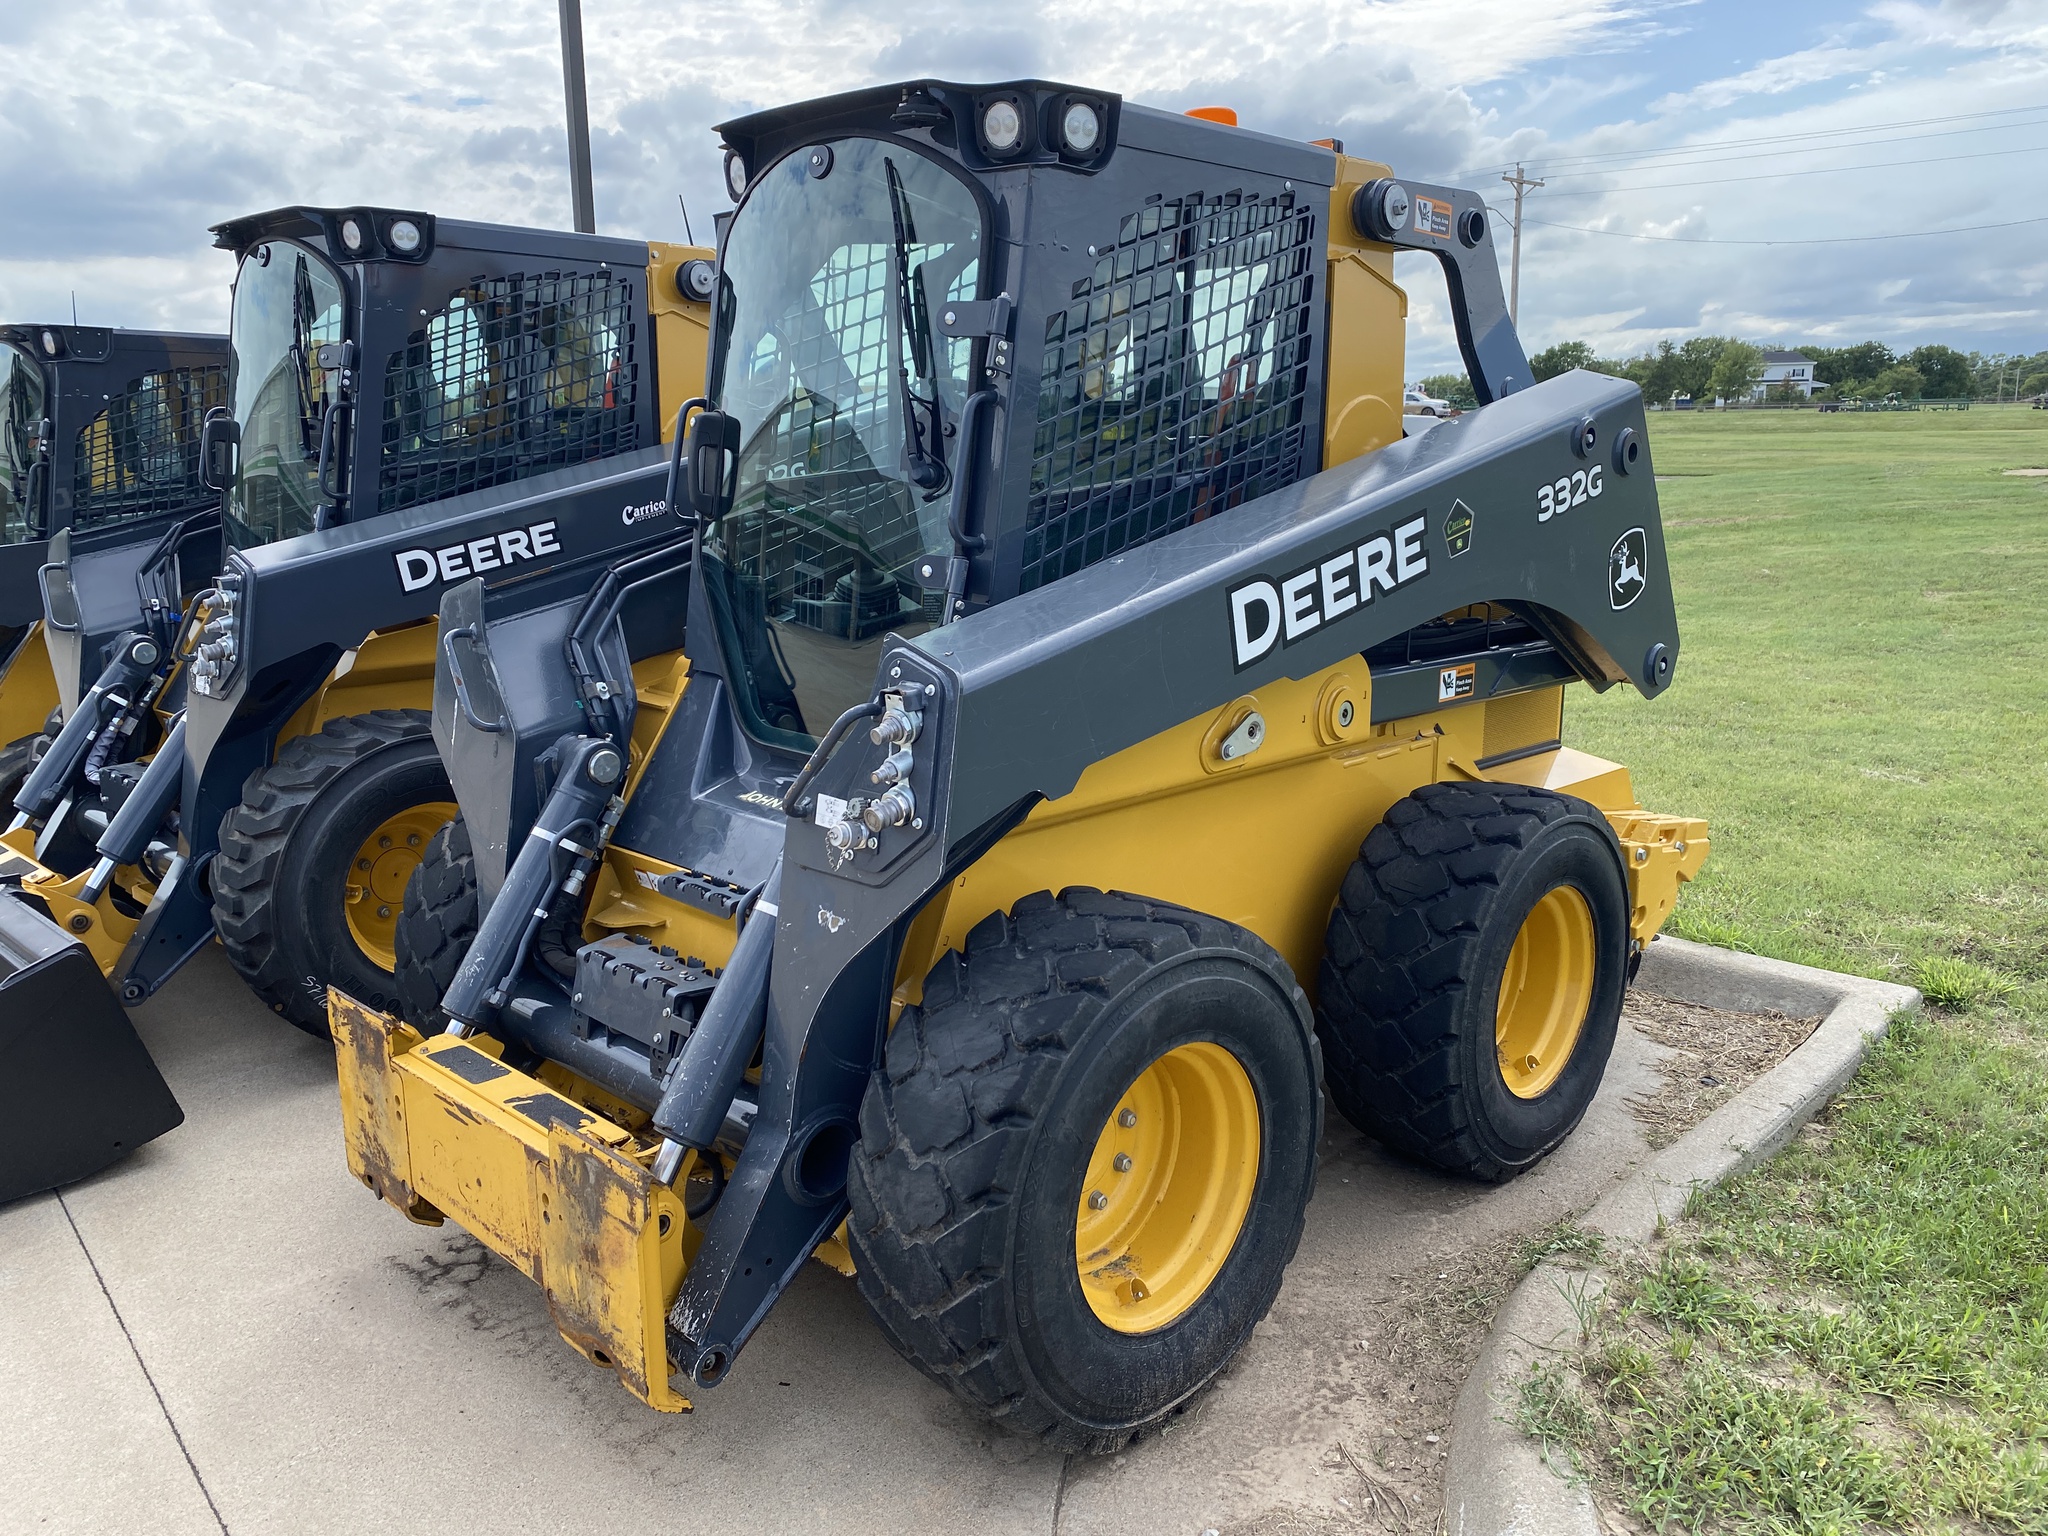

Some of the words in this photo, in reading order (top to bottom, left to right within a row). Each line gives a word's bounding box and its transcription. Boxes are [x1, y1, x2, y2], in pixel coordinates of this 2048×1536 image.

[622, 500, 666, 526] Carrico
[1537, 464, 1602, 522] 332G
[396, 521, 560, 592] DEERE
[1231, 516, 1427, 666] DEERE
[740, 790, 784, 808] JOHN
